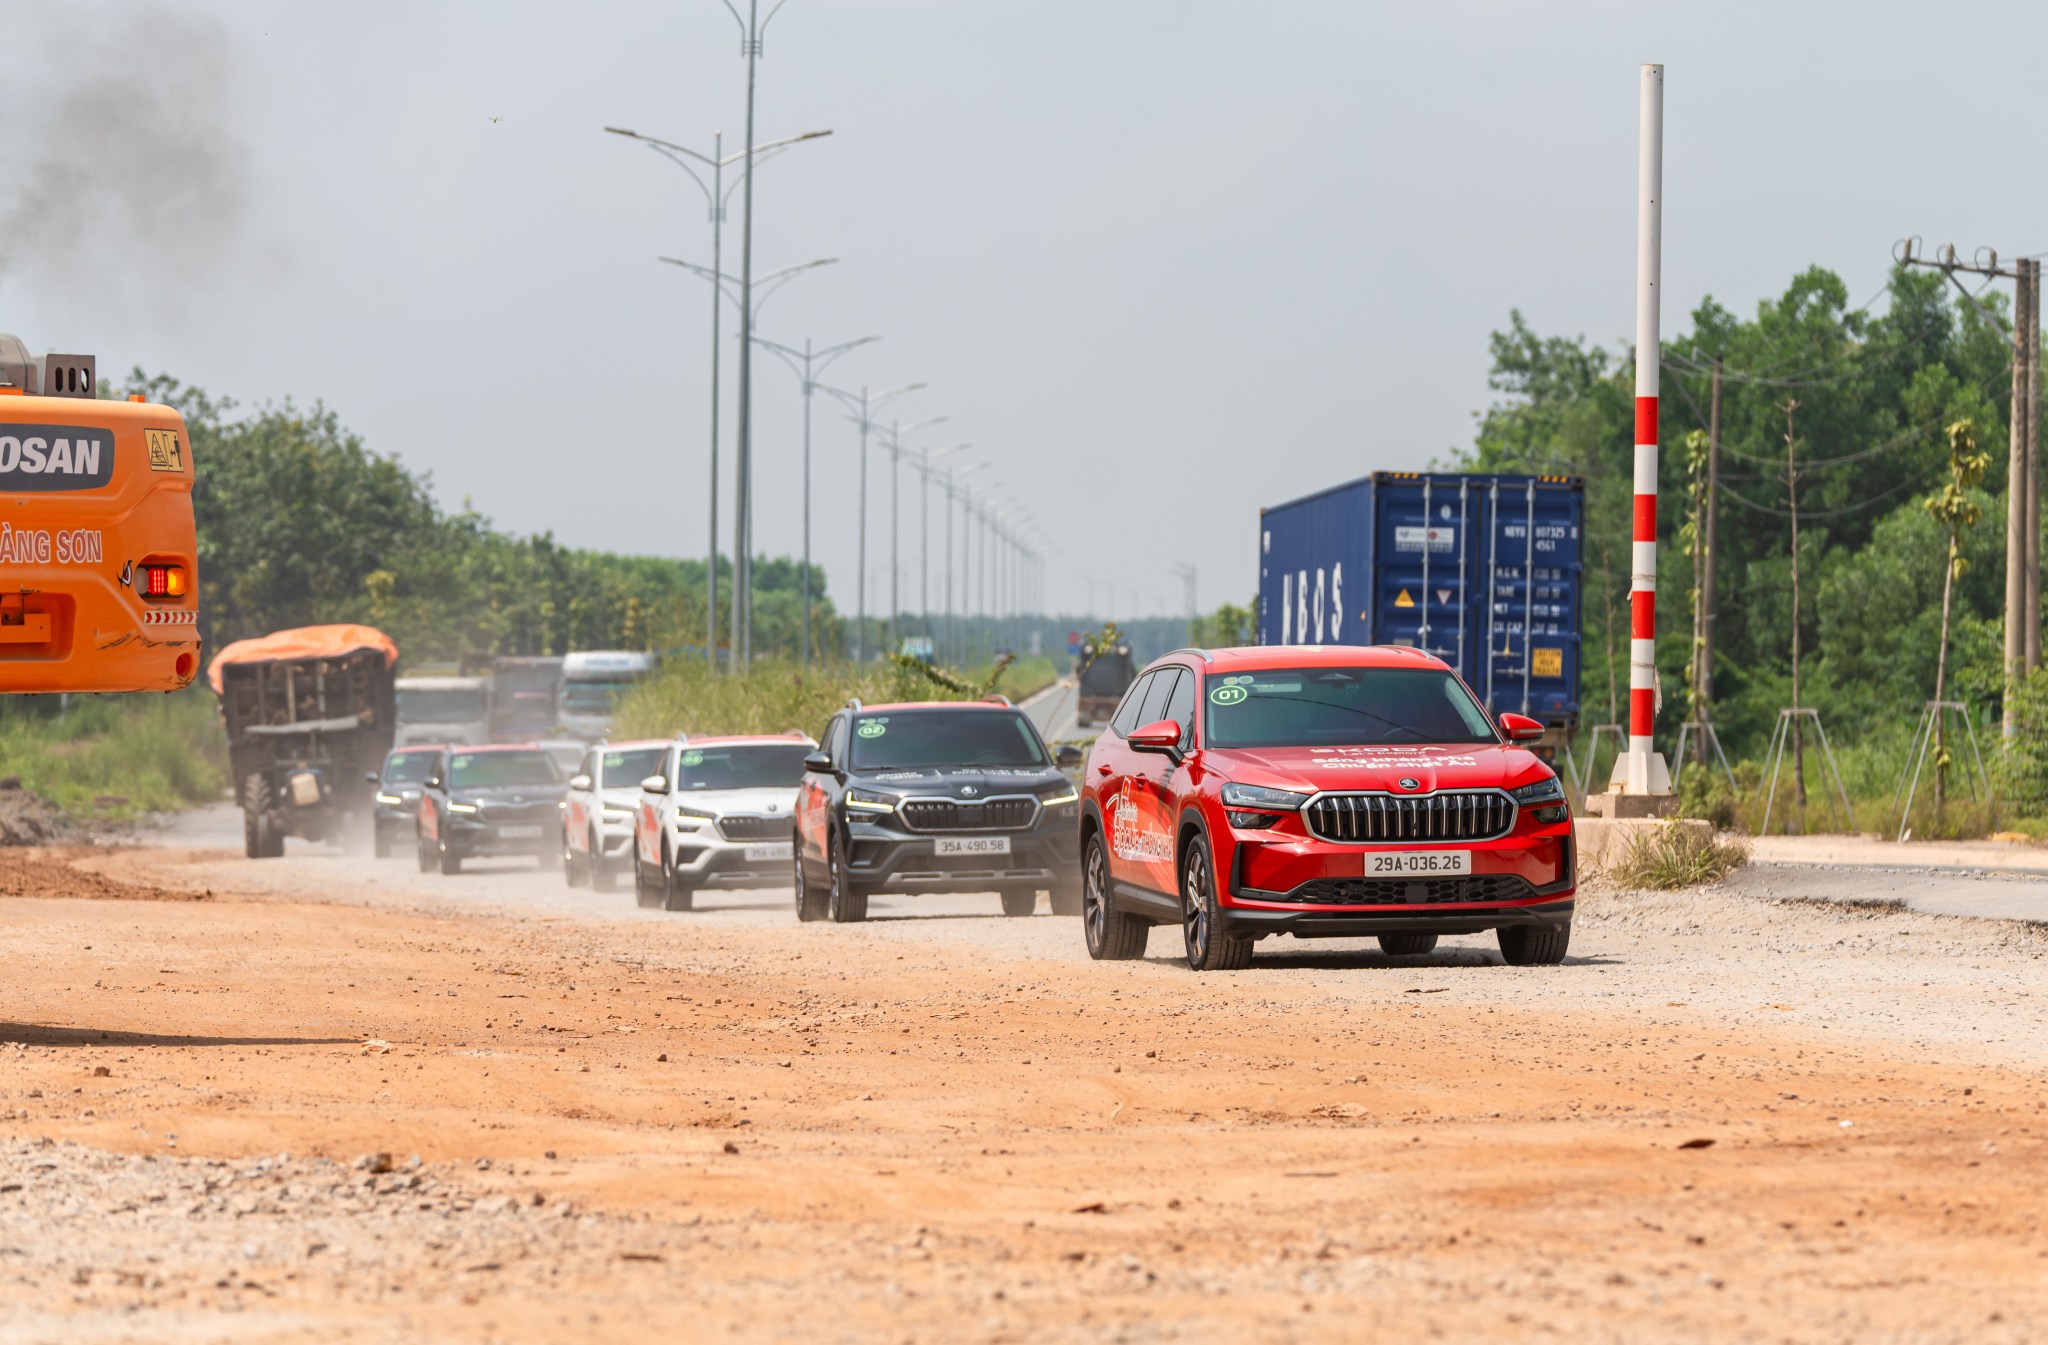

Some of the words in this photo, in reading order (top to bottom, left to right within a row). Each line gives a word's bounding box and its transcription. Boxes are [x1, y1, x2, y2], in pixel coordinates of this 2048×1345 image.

[0, 436, 100, 475] OSAN
[0, 522, 51, 564] ÀNG
[56, 528, 103, 564] SƠN
[1218, 689, 1239, 700] 01
[863, 726, 881, 736] 02
[1374, 855, 1462, 872] 29A-036.26
